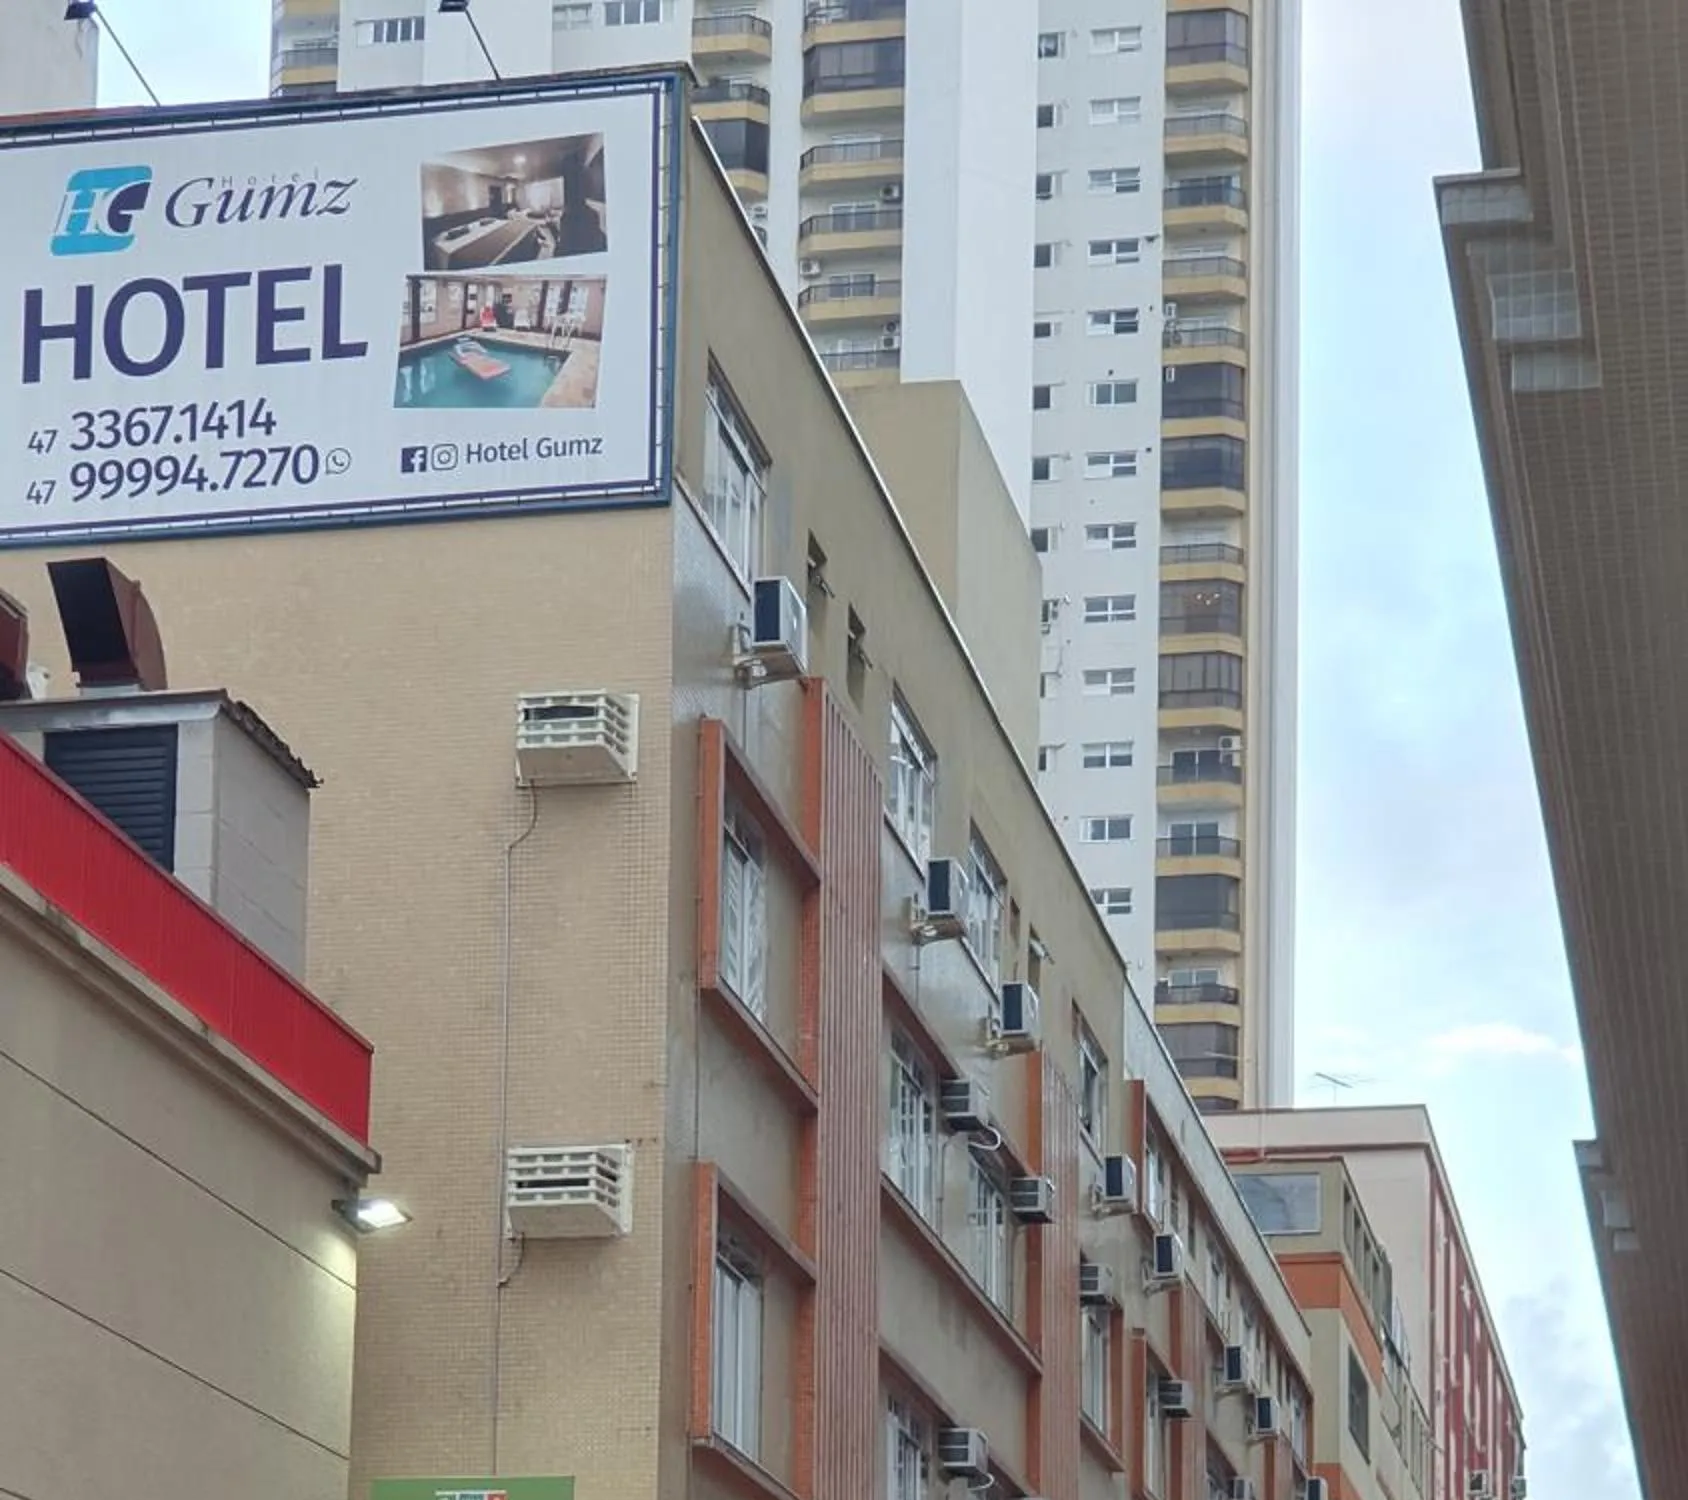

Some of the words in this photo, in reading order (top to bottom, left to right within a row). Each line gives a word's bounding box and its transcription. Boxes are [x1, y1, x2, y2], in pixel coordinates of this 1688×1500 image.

[164, 176, 359, 229] Gumz
[221, 166, 319, 187] Hotel
[22, 264, 368, 384] HOTEL
[27, 428, 58, 455] 47
[69, 397, 277, 451] 3367.1414
[466, 437, 529, 464] Hotel
[536, 437, 604, 459] Gumz
[25, 479, 56, 505] 47
[69, 444, 320, 503] 99994.7270
